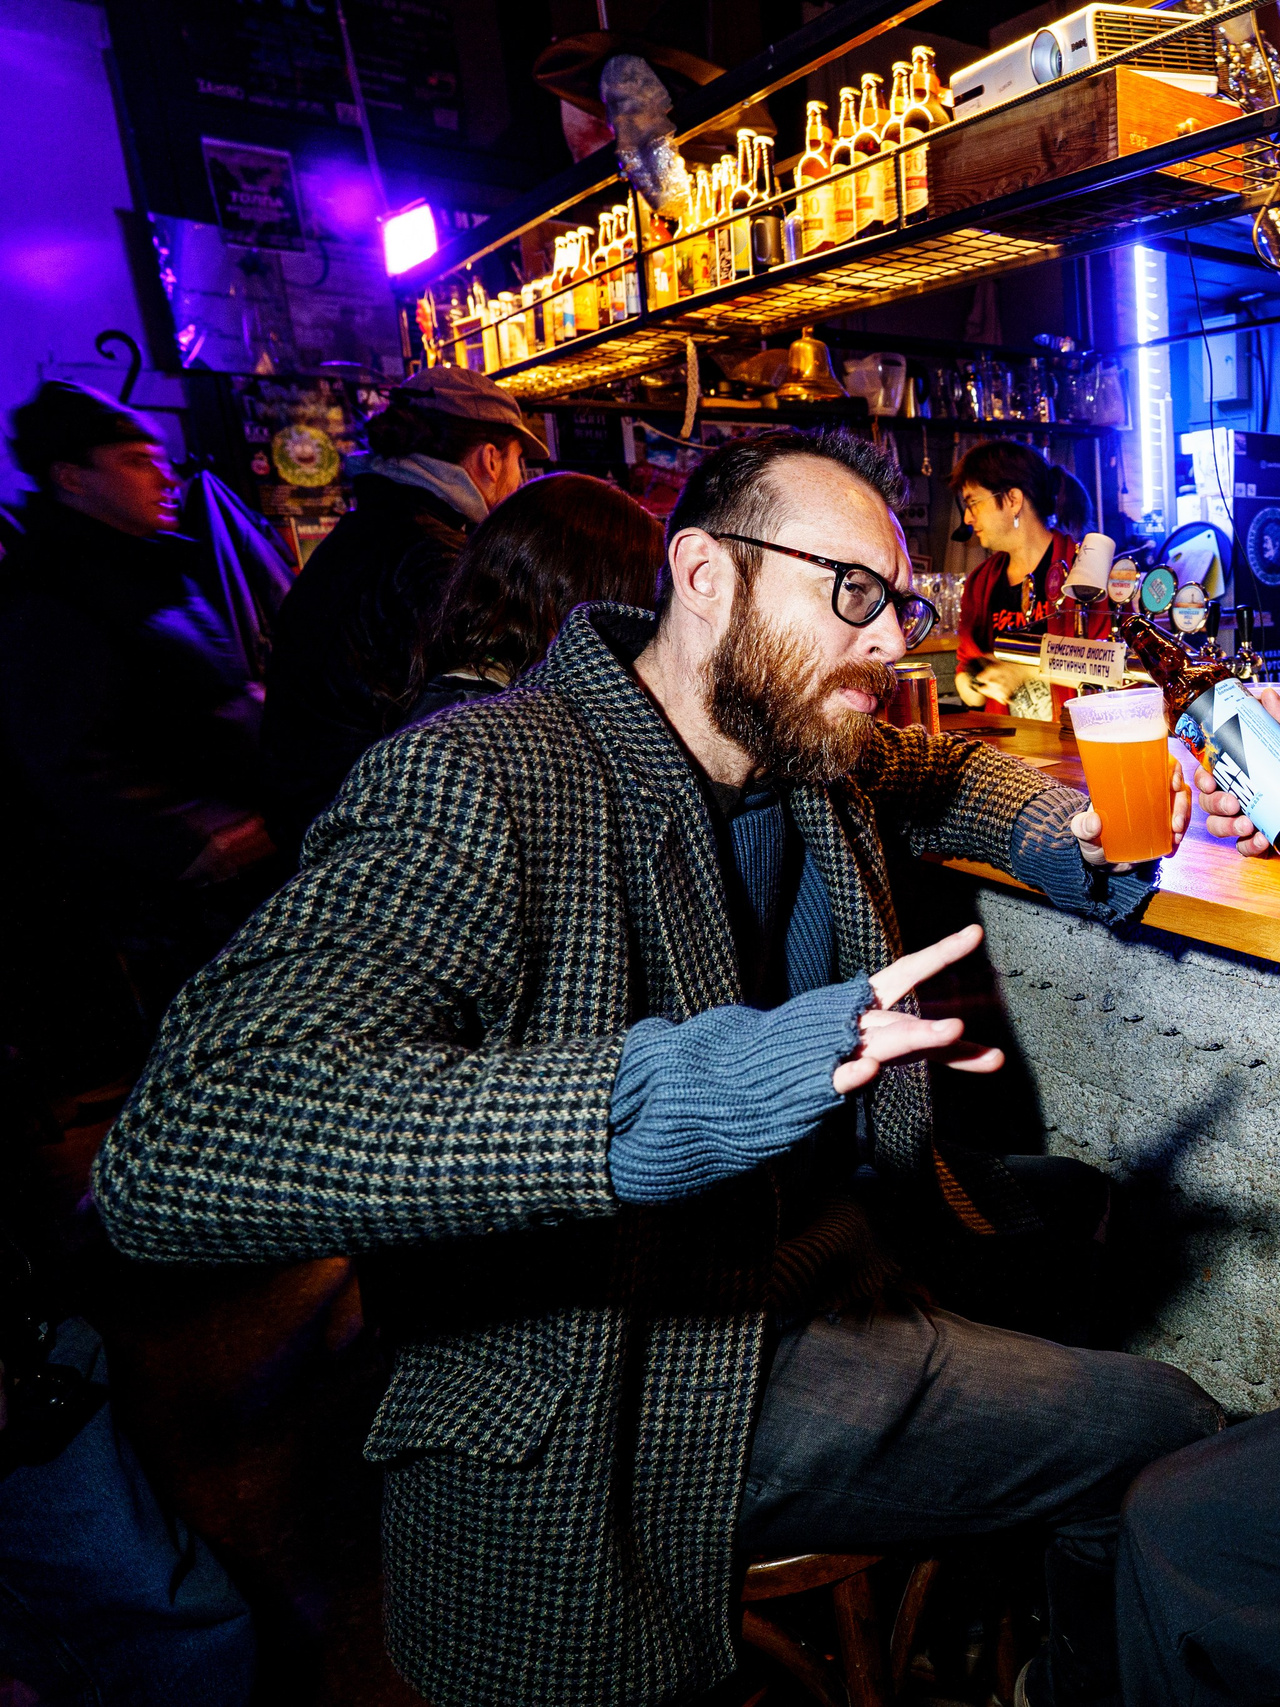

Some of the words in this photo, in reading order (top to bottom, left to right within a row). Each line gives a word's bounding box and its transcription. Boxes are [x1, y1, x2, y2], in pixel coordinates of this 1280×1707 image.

[1046, 640, 1086, 658] ЕЖЕМЕСЯЧНО
[1086, 647, 1115, 662] ВНОСИТЕ
[1049, 657, 1087, 674] КВАРТИРНУЮ
[1089, 663, 1110, 678] ПЛАТУ
